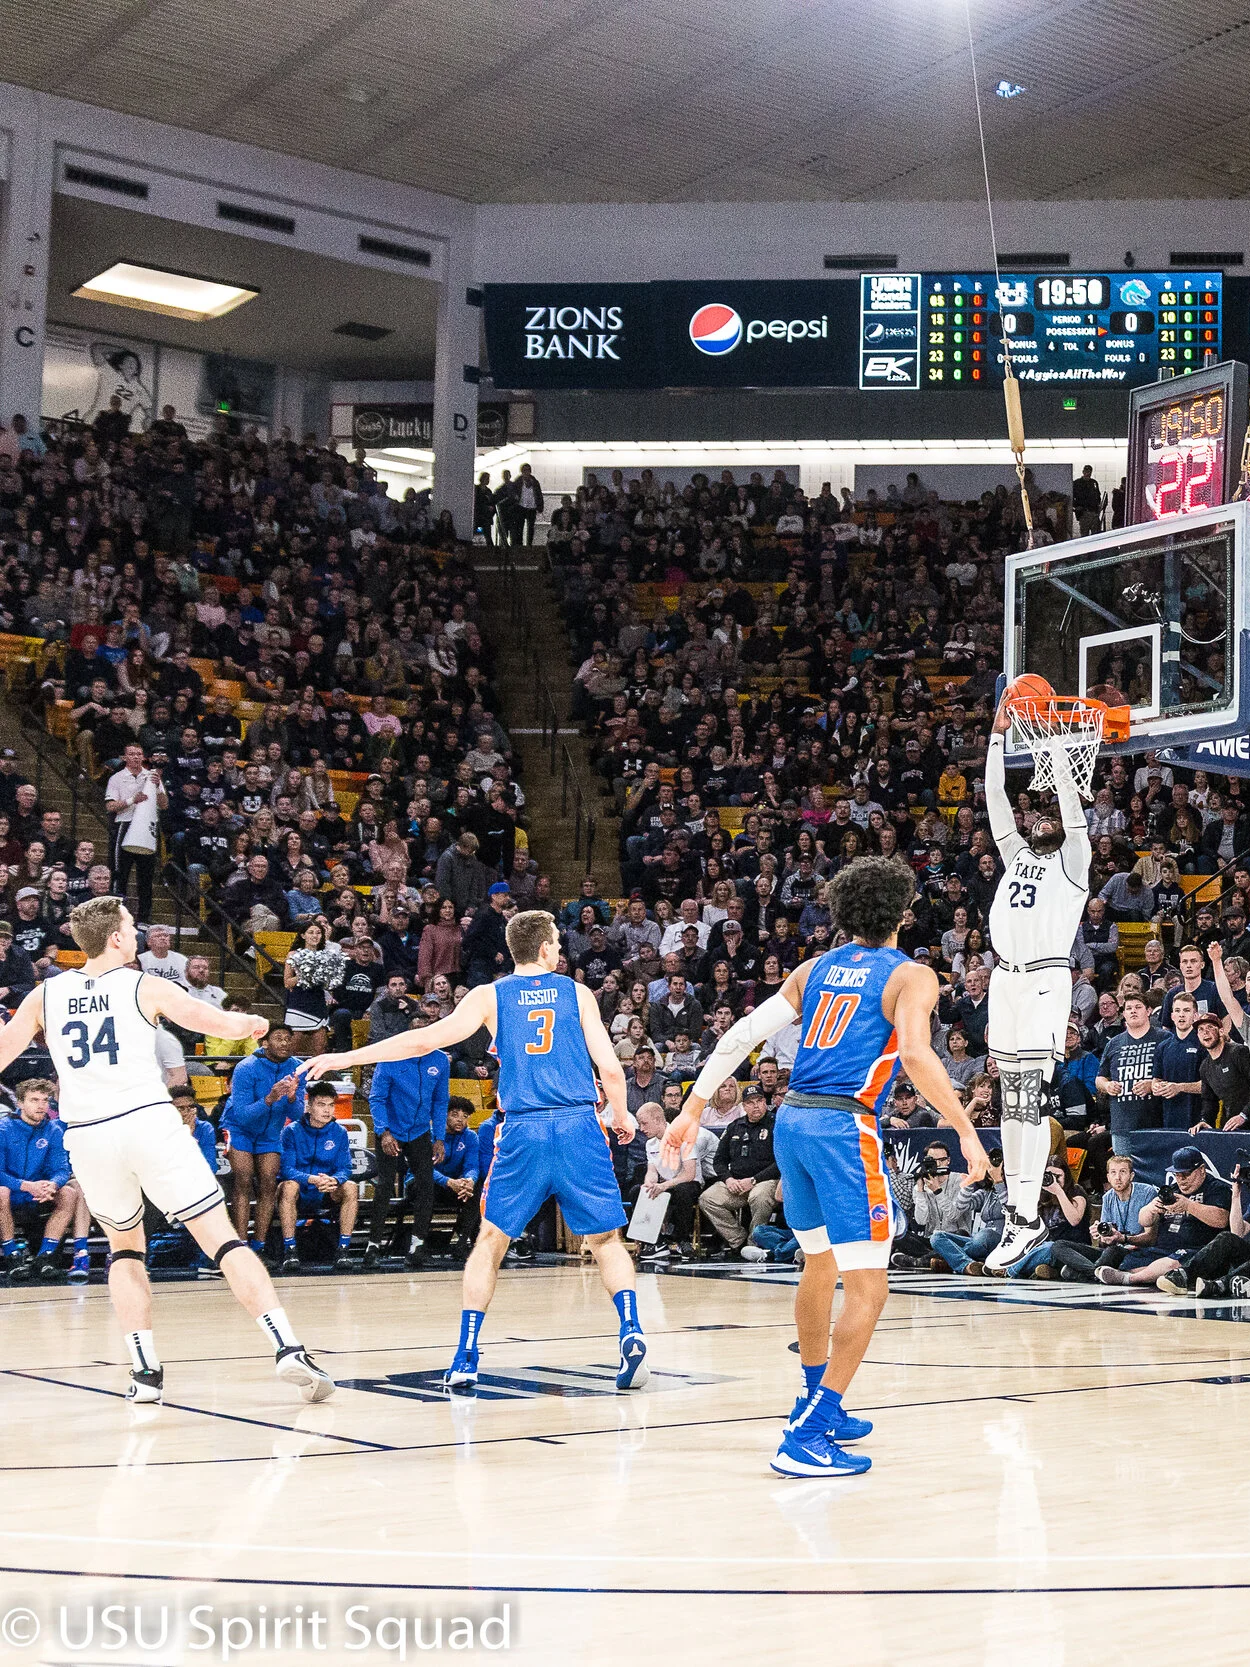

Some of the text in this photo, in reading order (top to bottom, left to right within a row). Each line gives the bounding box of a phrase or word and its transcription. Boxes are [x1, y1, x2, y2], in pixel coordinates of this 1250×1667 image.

[871, 277, 912, 291] UTAH
[1039, 278, 1102, 306] 19:50
[1184, 293, 1193, 305] 0
[1205, 293, 1213, 305] 0
[973, 294, 981, 307] 0
[525, 306, 624, 331] ZIONS
[931, 313, 945, 326] 15
[973, 313, 981, 326] 0
[1004, 314, 1017, 333] 0
[1052, 314, 1094, 324] PERIOD 1
[1125, 313, 1138, 332] 0
[1162, 311, 1213, 323] 10 0 0
[15, 326, 34, 347] C
[747, 315, 828, 343] pepsi
[885, 326, 917, 338] pepsi
[1046, 327, 1096, 336] POSSESSION
[1161, 330, 1213, 342] 21 0 0
[929, 332, 944, 344] 22
[973, 332, 981, 344] 0
[1008, 341, 1037, 349] BONUS
[1048, 341, 1095, 350] 4 TOL 4
[1106, 340, 1135, 349] BONUS
[524, 334, 621, 361] BANK
[1161, 348, 1192, 360] 23 0
[929, 350, 944, 363] 23
[973, 350, 981, 363] 0
[1012, 355, 1039, 363] FOULS
[1104, 353, 1145, 362] FOULS 0
[864, 357, 914, 376] EK
[928, 368, 980, 381] 34 0 0
[1019, 368, 1126, 381] #AggiesAllTheWay
[389, 417, 431, 439] Lucky
[453, 413, 468, 431] D
[1155, 445, 1214, 520] 22
[1014, 857, 1047, 881] TATE
[1008, 881, 1037, 908] 23
[147, 965, 180, 980] State
[823, 965, 871, 988] DENNIS
[1012, 965, 1020, 973] A
[68, 994, 110, 1015] BEAN
[517, 988, 558, 1006] JESSUP
[803, 990, 862, 1050] 10
[525, 1008, 556, 1055] 3
[61, 1016, 120, 1069] 34
[1117, 1063, 1154, 1081] TRUE
